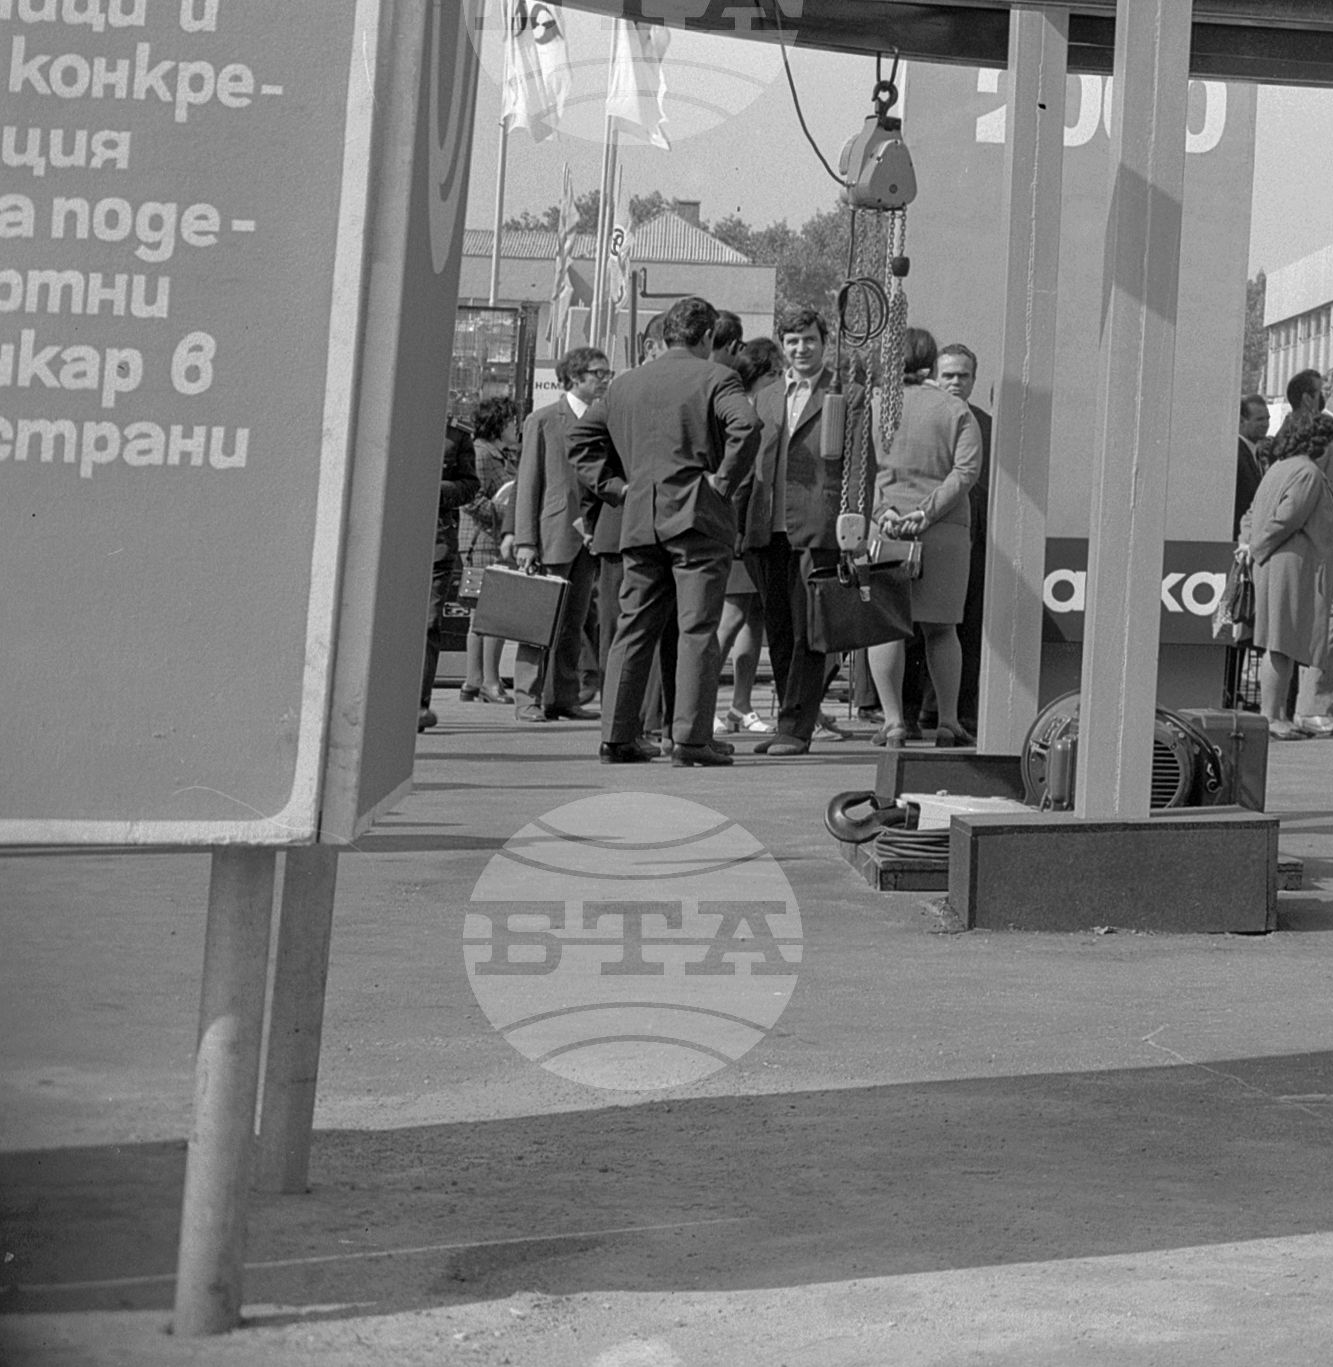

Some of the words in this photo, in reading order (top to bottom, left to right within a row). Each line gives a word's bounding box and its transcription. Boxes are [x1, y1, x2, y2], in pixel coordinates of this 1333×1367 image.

[9, 35, 283, 123] конкре-
[1, 126, 132, 176] ция
[51, 197, 256, 263] поде-
[171, 332, 217, 396] в
